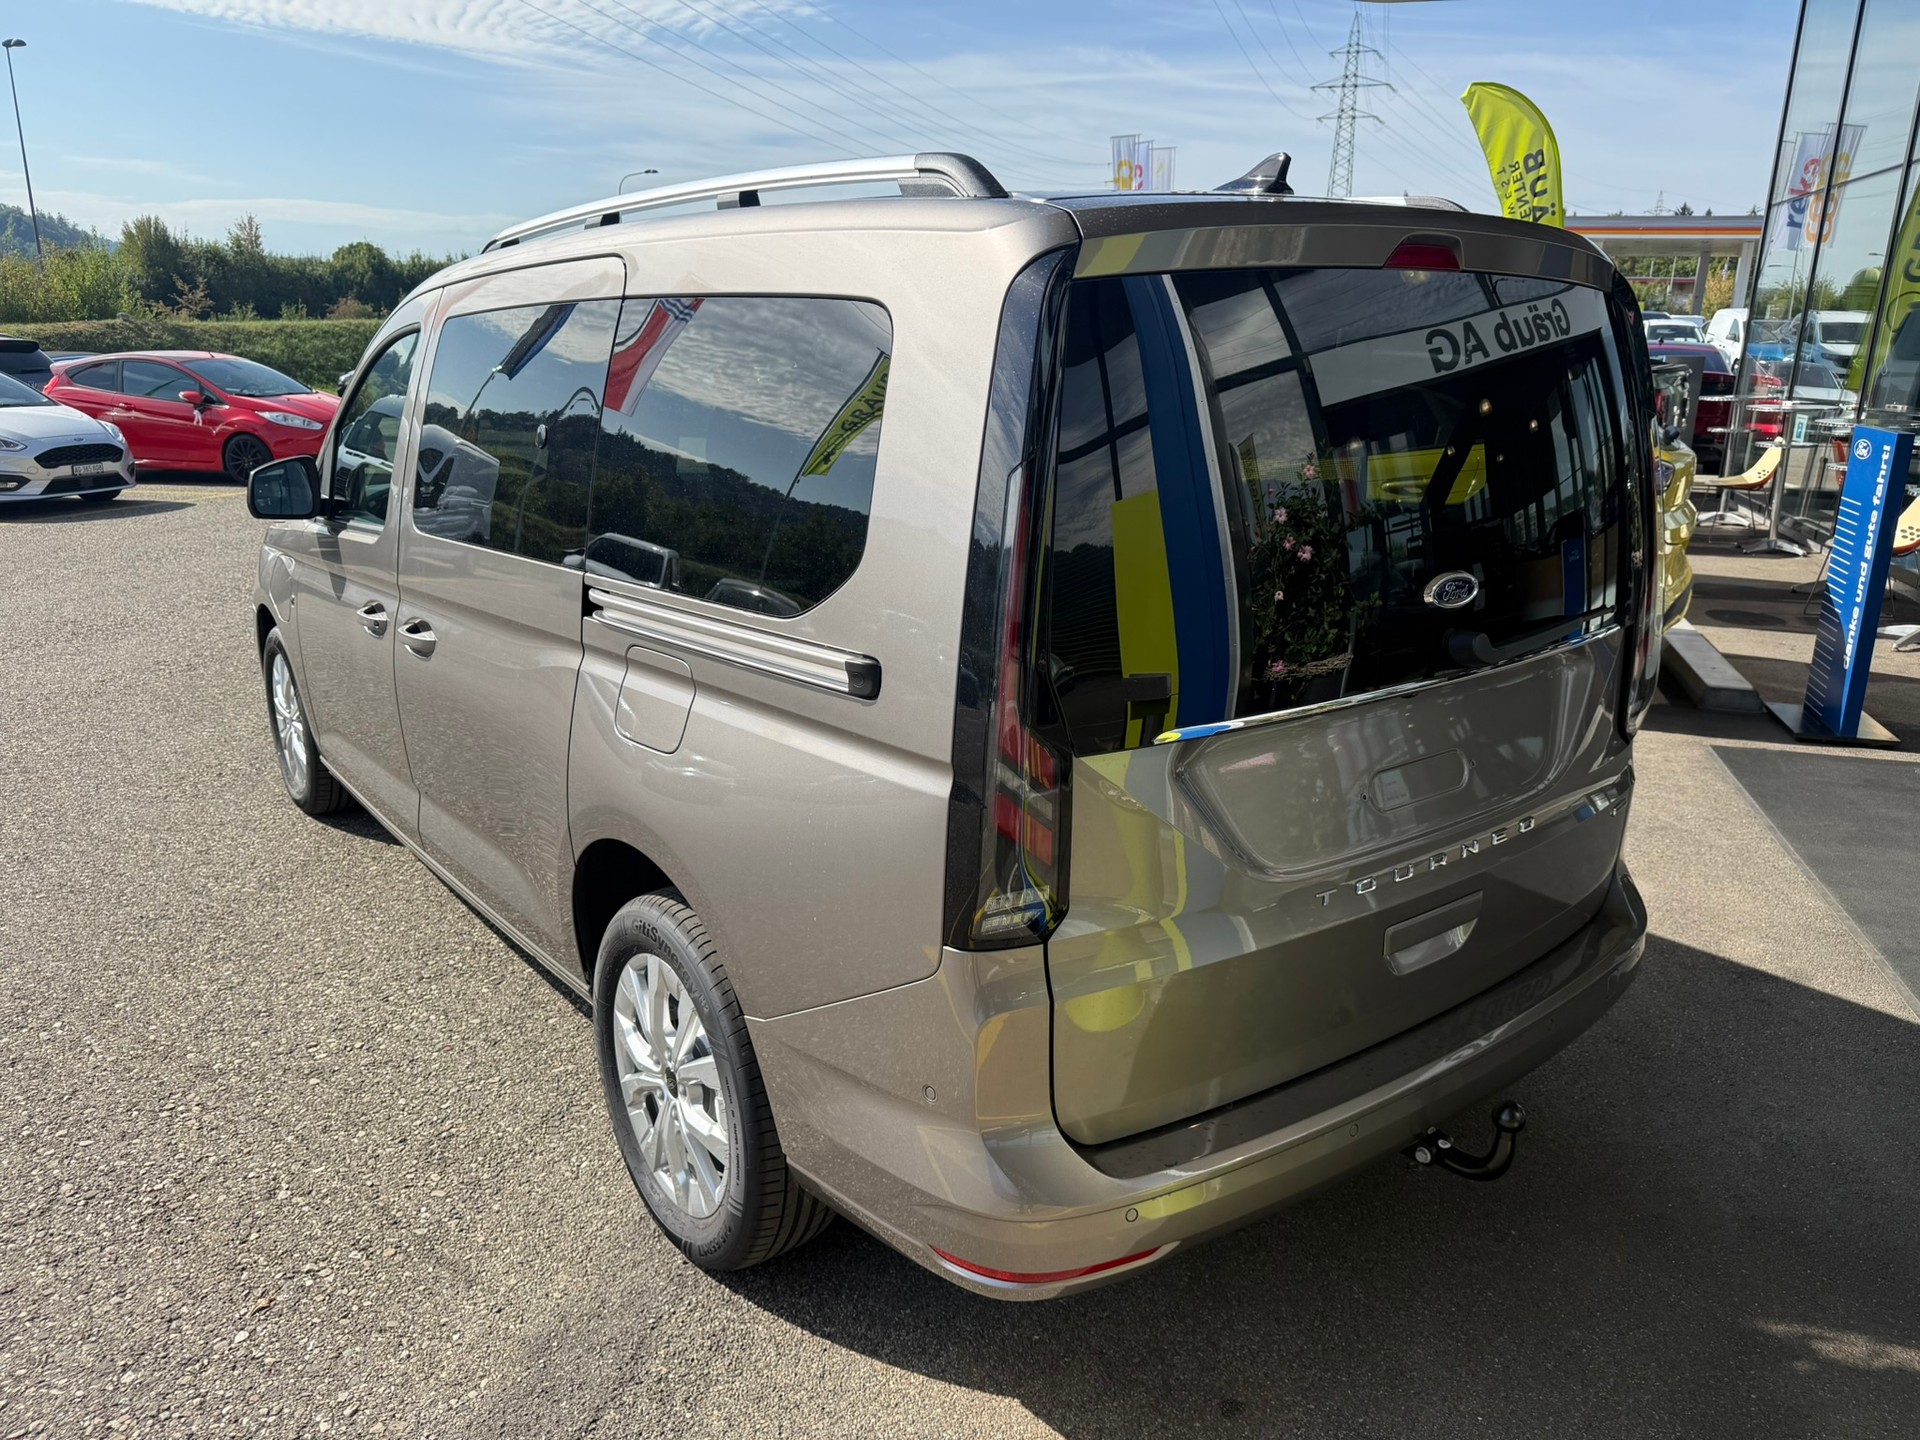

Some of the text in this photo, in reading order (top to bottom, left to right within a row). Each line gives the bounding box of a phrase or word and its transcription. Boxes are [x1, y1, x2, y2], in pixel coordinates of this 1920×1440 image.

[1843, 606, 1862, 670] danke
[1856, 561, 1868, 606] und
[1864, 509, 1878, 560] gute
[1314, 815, 1535, 906] TOURNEO
